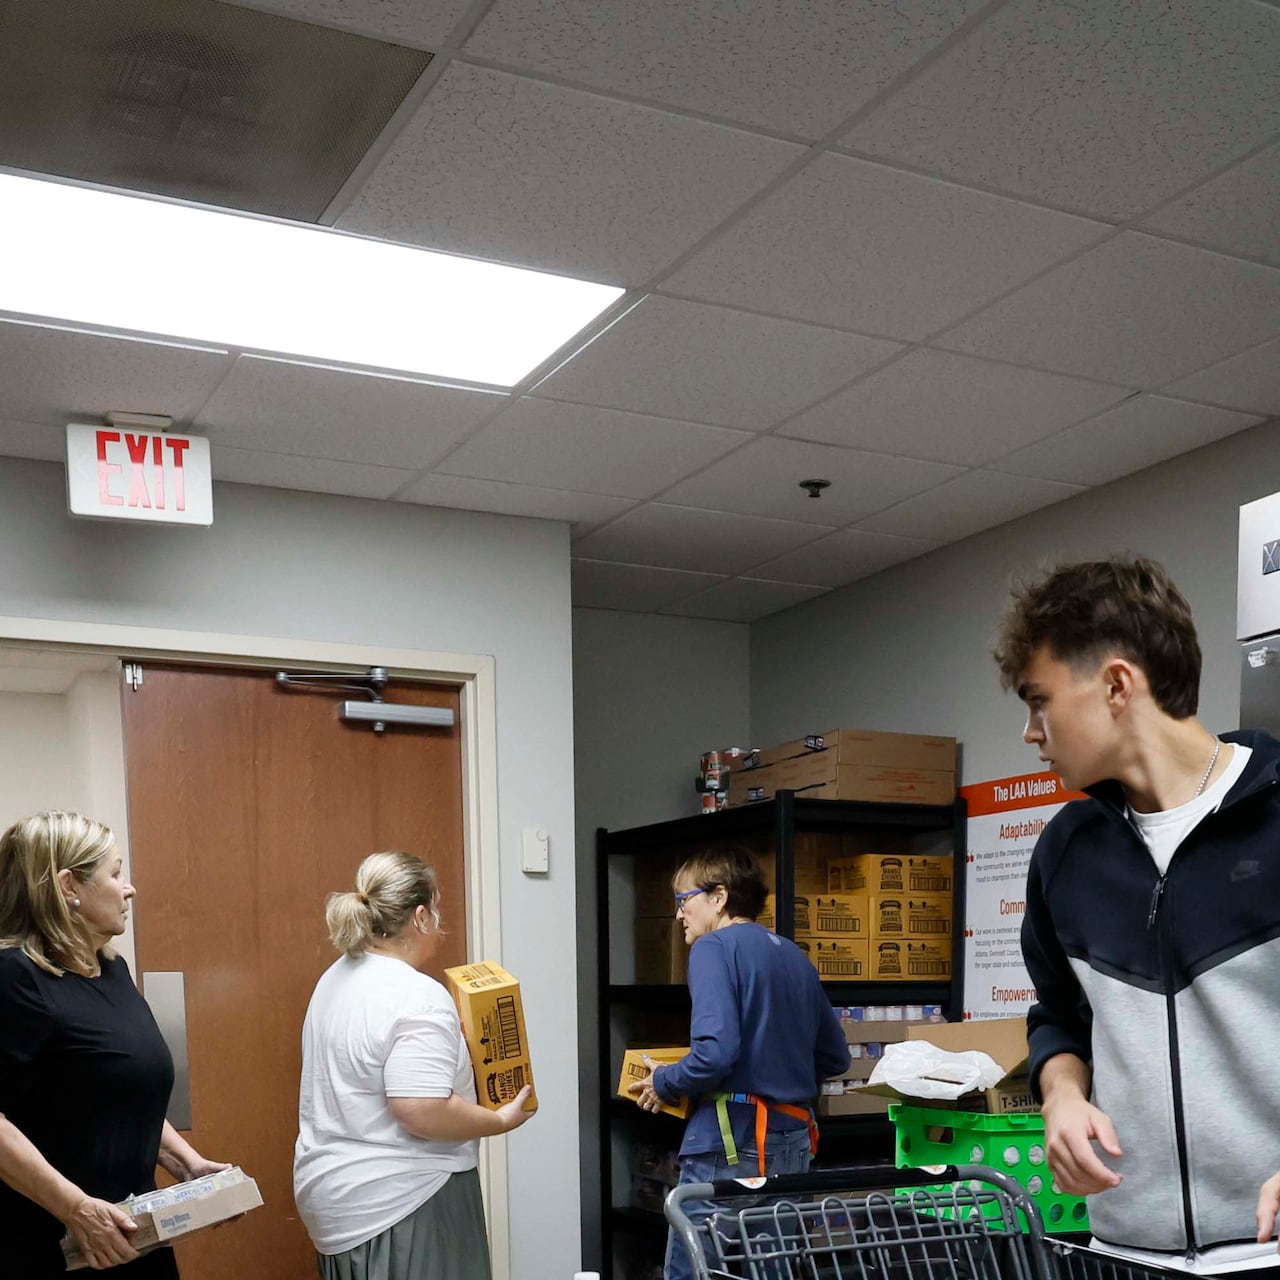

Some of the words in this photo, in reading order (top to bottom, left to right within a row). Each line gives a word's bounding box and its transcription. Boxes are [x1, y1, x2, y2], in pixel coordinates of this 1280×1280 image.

[96, 431, 190, 511] EXIT
[993, 785, 1009, 802] The
[1009, 782, 1027, 800] LAA
[1027, 778, 1057, 798] Values
[497, 1072, 508, 1100] MANGO
